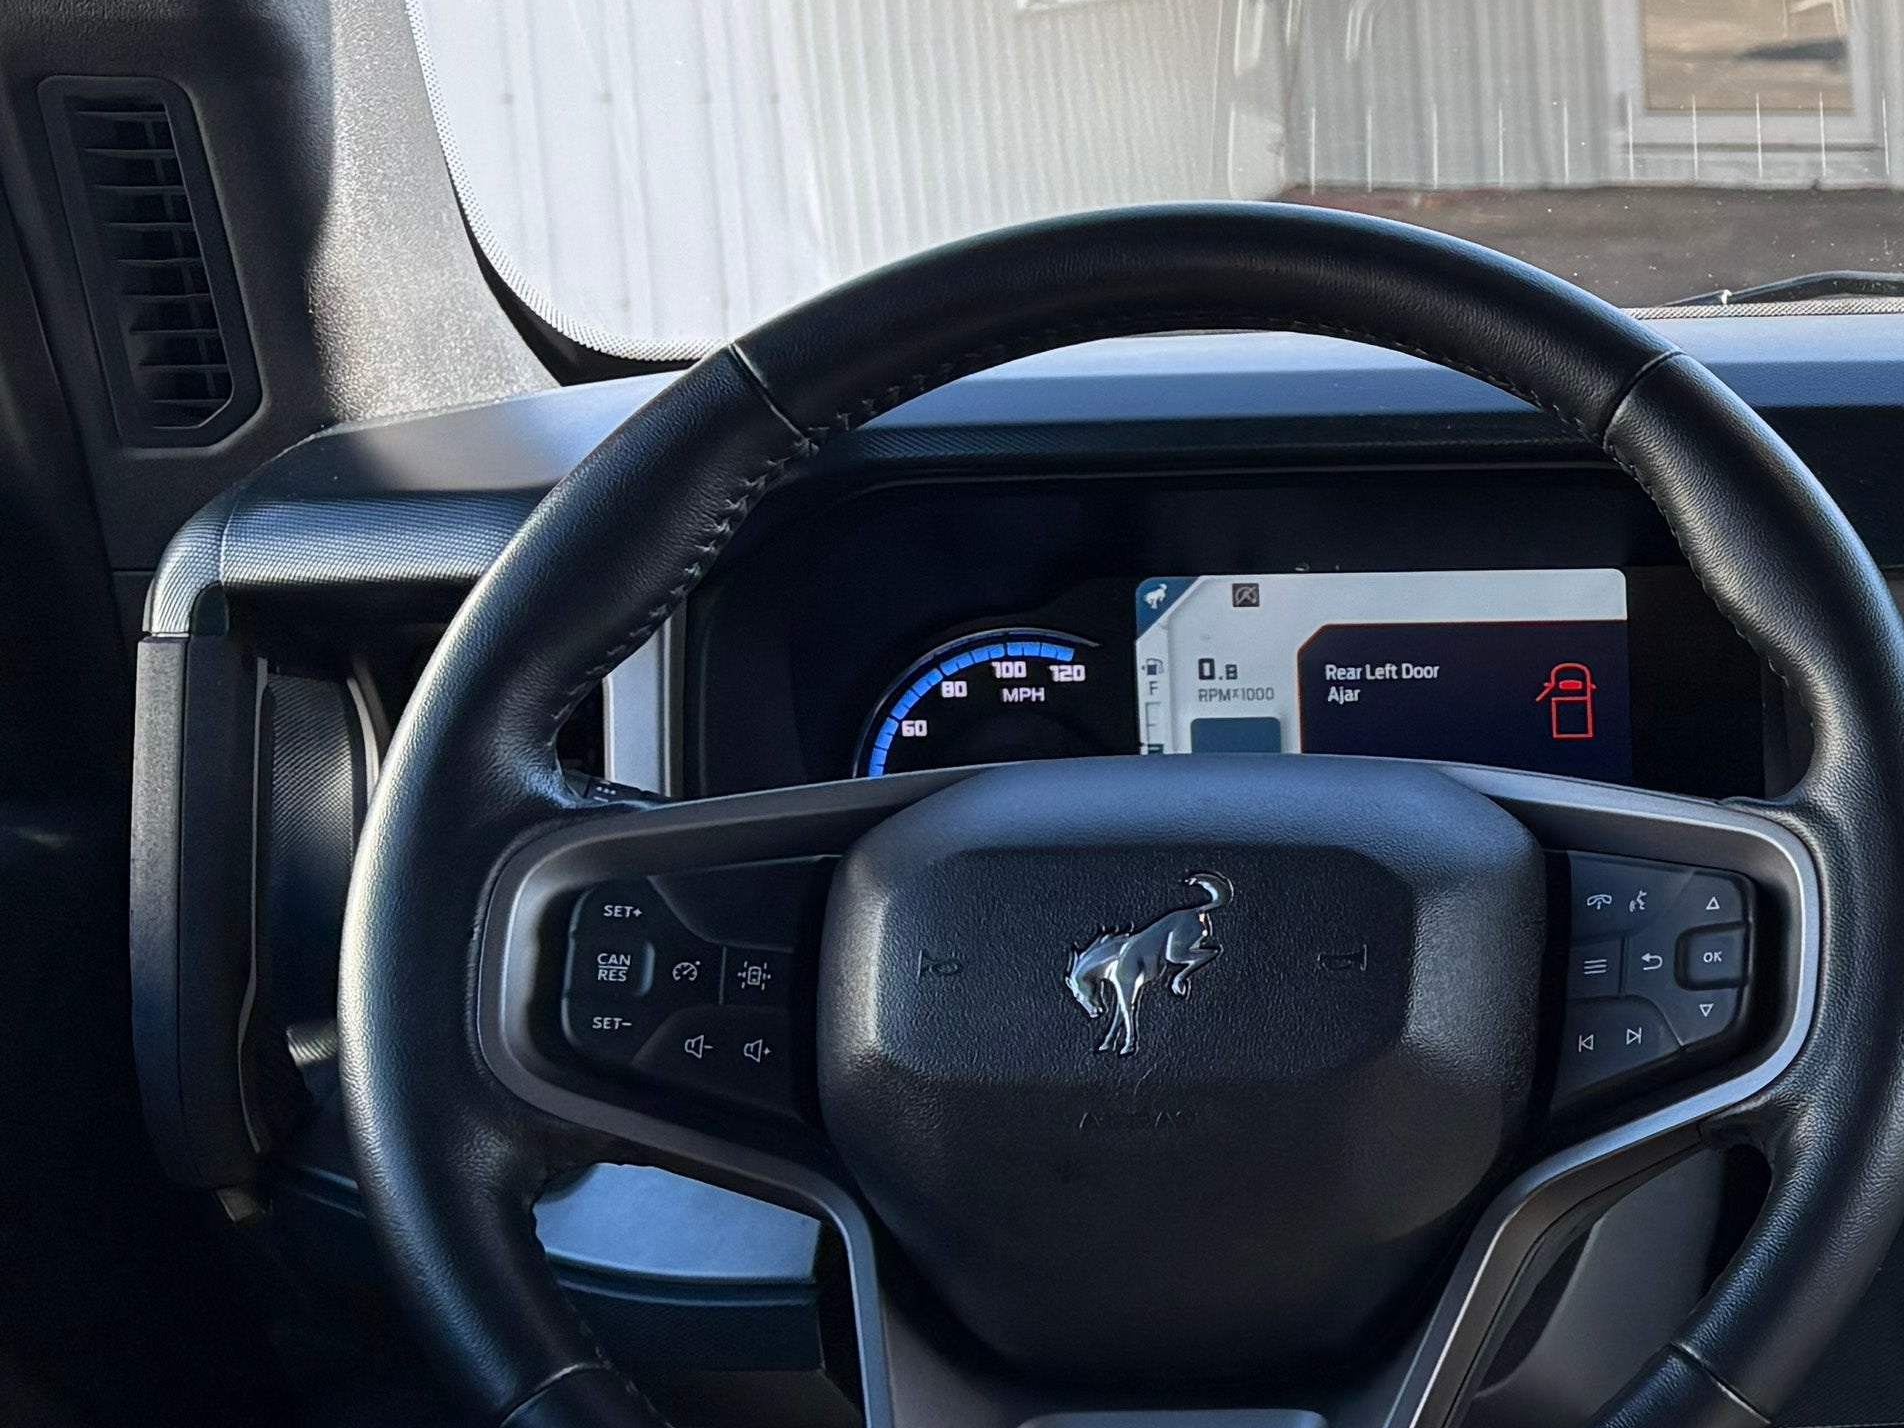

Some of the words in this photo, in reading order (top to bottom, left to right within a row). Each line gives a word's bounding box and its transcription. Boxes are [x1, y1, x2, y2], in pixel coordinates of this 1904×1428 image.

[992, 660, 1027, 679] 100
[1049, 663, 1087, 682] 120
[1325, 663, 1363, 680] Rear
[1365, 663, 1399, 680] Left
[1401, 662, 1440, 679] Door
[941, 680, 968, 698] 80
[1002, 687, 1046, 703] MPH
[1148, 681, 1159, 696] F
[1327, 686, 1361, 704] Ajar
[901, 719, 928, 737] 60
[597, 953, 631, 967] CAN
[1702, 950, 1722, 963] OK
[597, 969, 628, 982] RES
